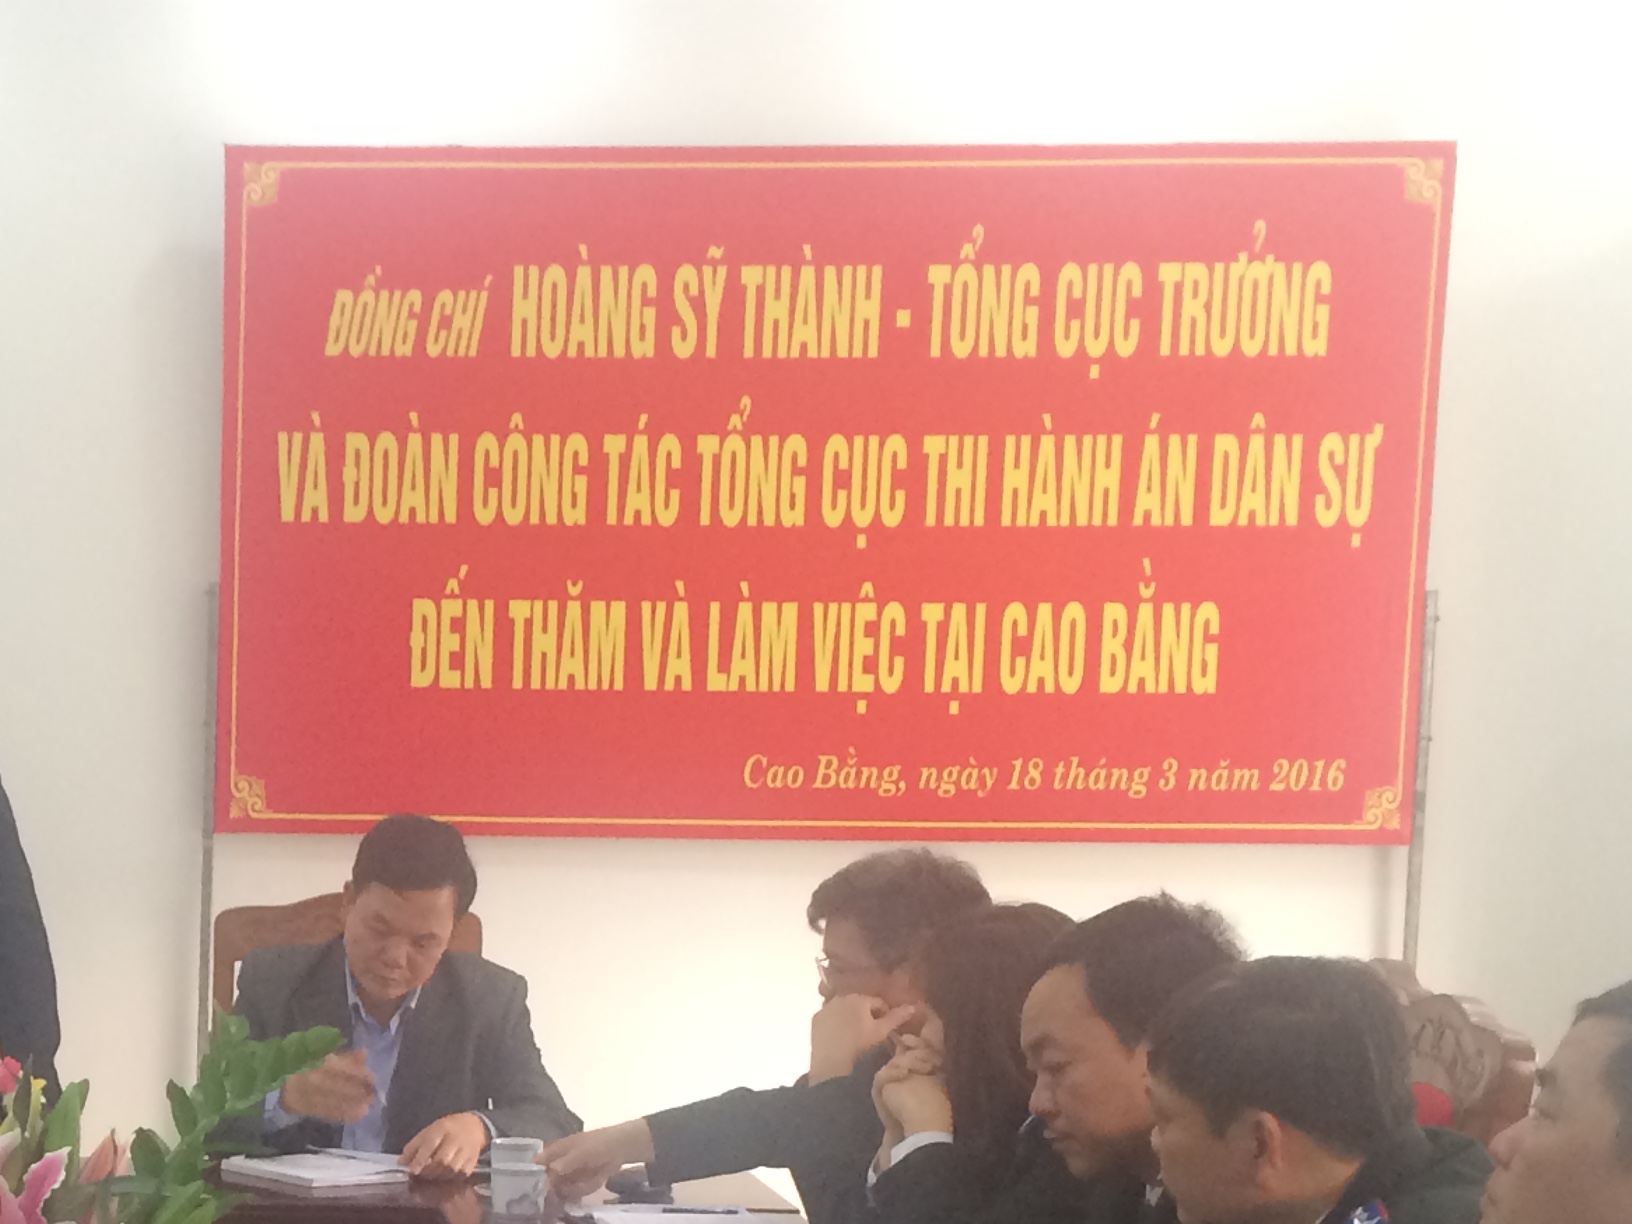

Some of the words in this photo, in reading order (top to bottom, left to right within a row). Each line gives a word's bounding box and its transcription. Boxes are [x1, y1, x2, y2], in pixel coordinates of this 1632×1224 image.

[325, 266, 421, 358] ĐỒNG
[426, 276, 492, 357] CHÍ
[511, 244, 656, 358] HOÀNG
[672, 246, 726, 359] SỸ
[741, 245, 882, 358] THÀNH
[897, 310, 910, 327] -
[928, 224, 1040, 358] TỔNG
[1055, 262, 1142, 379] CỤC
[1159, 220, 1331, 357] TRƯỞNG
[278, 411, 328, 522] VÀ
[343, 412, 458, 524] ĐOÀN
[474, 413, 588, 526] CÔNG
[604, 414, 681, 527] TÁC
[697, 396, 806, 527] TỔNG
[822, 434, 907, 549] CỤC
[924, 435, 988, 526] THI
[1001, 414, 1122, 526] HÀNH
[1133, 413, 1197, 526] ÁN
[1210, 413, 1303, 526] DÂN
[1315, 424, 1383, 547] SỰ
[410, 565, 494, 688] ĐẾN
[509, 580, 625, 690] THĂM
[641, 580, 691, 691] VÀ
[707, 581, 798, 692] LÀM
[814, 582, 905, 714] VIỆC
[922, 602, 986, 715] TẠI
[1000, 602, 1085, 694] CAO
[1100, 558, 1219, 694] BẰNG
[744, 754, 804, 788] Cao
[812, 747, 906, 796] Bằng,
[919, 757, 997, 797] ngày
[1008, 758, 1043, 789] 18
[1054, 757, 1151, 798] tháng
[1159, 758, 1178, 791] 3
[1188, 760, 1259, 790] năm
[1269, 759, 1346, 791] 2016
